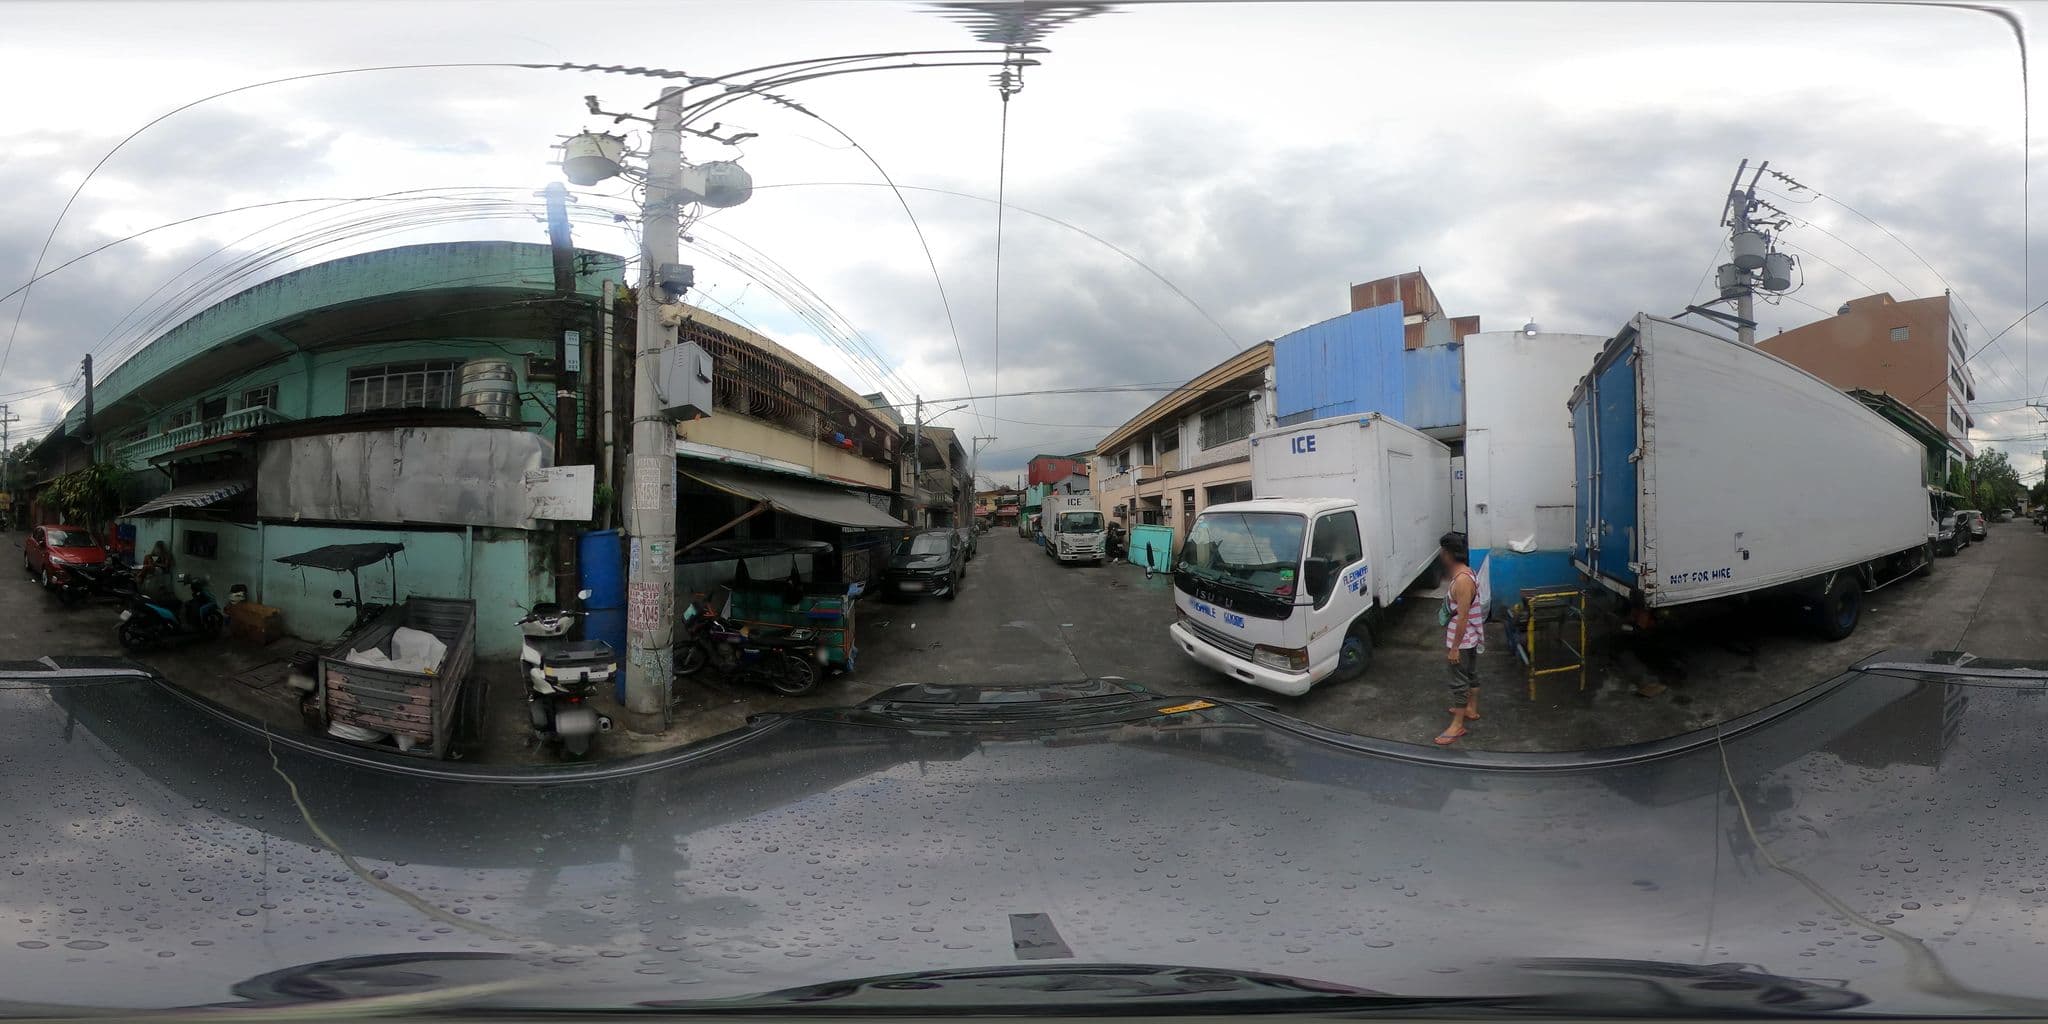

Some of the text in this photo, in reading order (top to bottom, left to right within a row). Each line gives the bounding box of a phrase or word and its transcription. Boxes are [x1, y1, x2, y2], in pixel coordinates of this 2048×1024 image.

[1291, 434, 1316, 455] ICE
[1454, 470, 1464, 480] ICE
[1067, 498, 1081, 506] ICE
[1670, 567, 1732, 584] NOT FOR HIRE
[1195, 588, 1233, 609] ISUU
